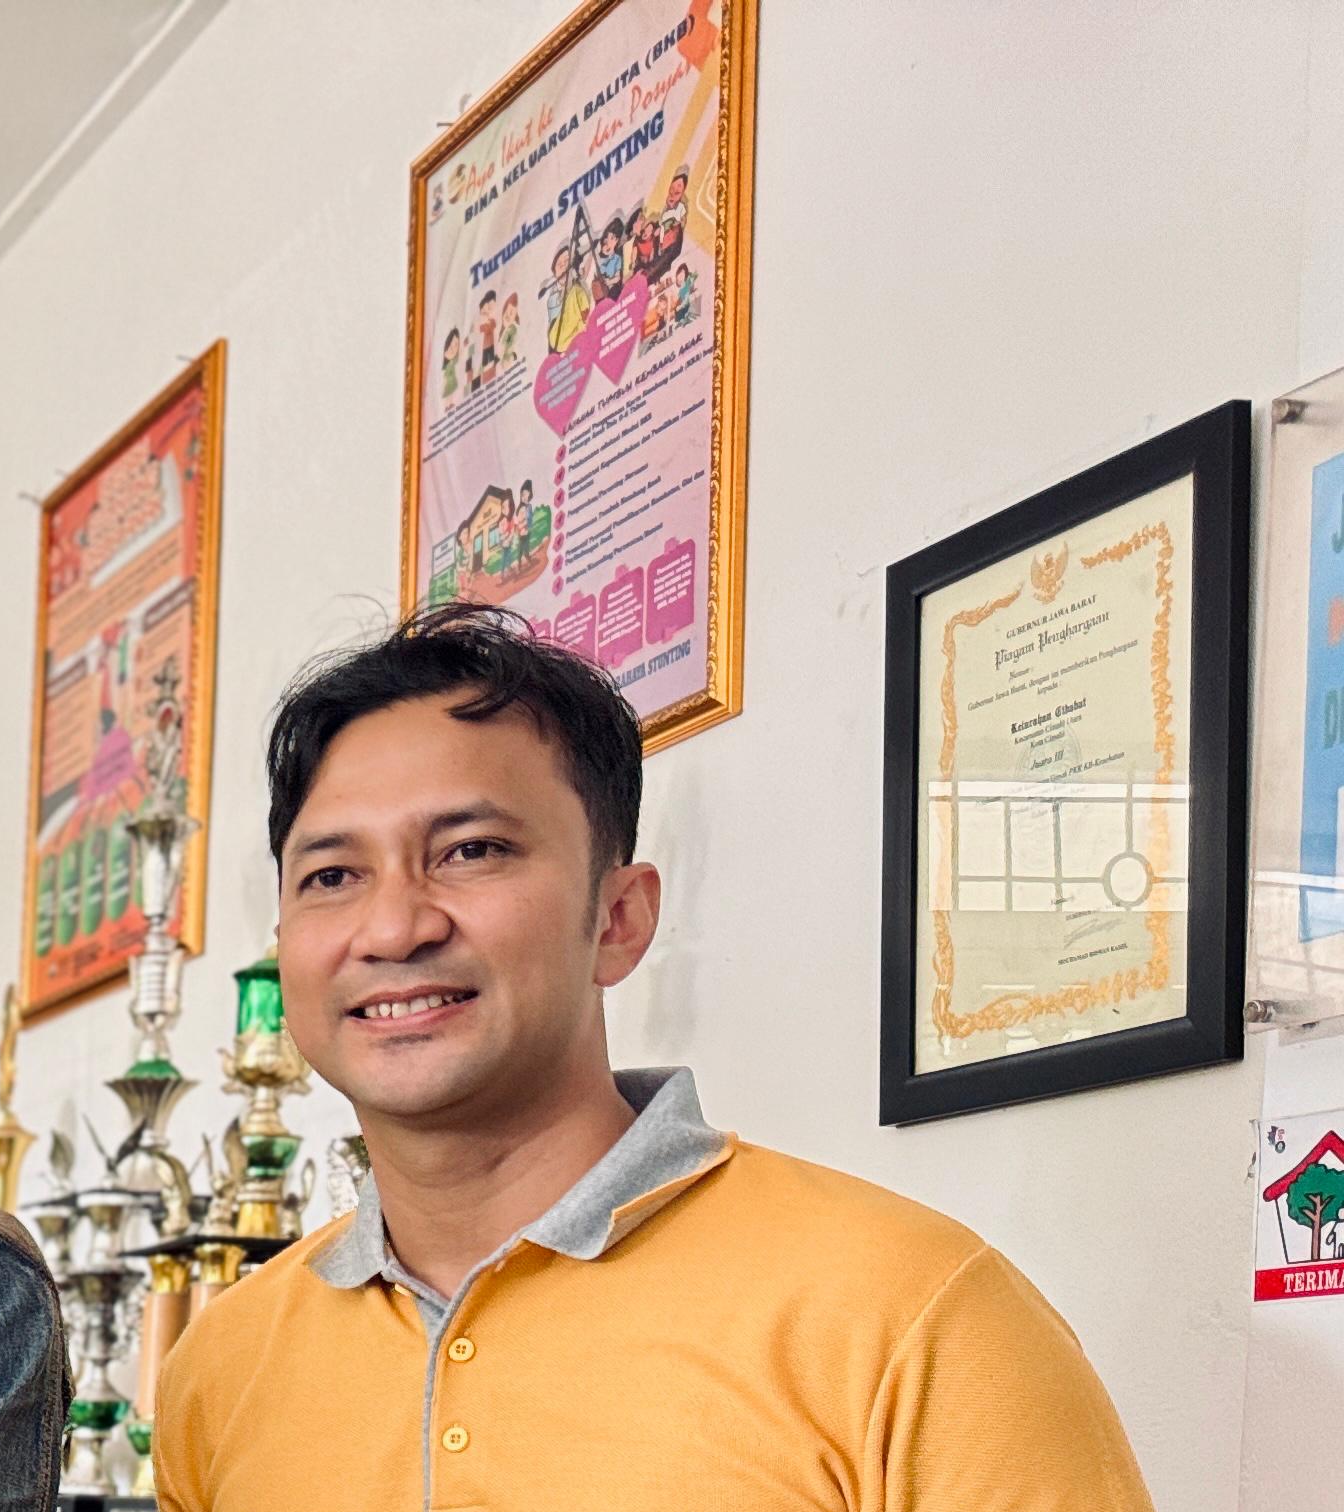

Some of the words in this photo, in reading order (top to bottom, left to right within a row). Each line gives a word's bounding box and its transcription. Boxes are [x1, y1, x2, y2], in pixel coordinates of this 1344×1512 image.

[464, 185, 499, 224] BINA
[503, 114, 580, 193] KELUARGA
[583, 60, 640, 122] BALITA
[644, 14, 695, 69] (BKB)
[470, 208, 554, 289] Turunkan
[557, 109, 665, 219] STUNTING
[994, 642, 1035, 671] Piagam
[1037, 611, 1110, 652] Penghargaan
[1006, 615, 1049, 640] GUBERNUR
[1050, 608, 1070, 624] JAWA
[1071, 594, 1097, 613] BARAT
[647, 639, 691, 675] STUNTING
